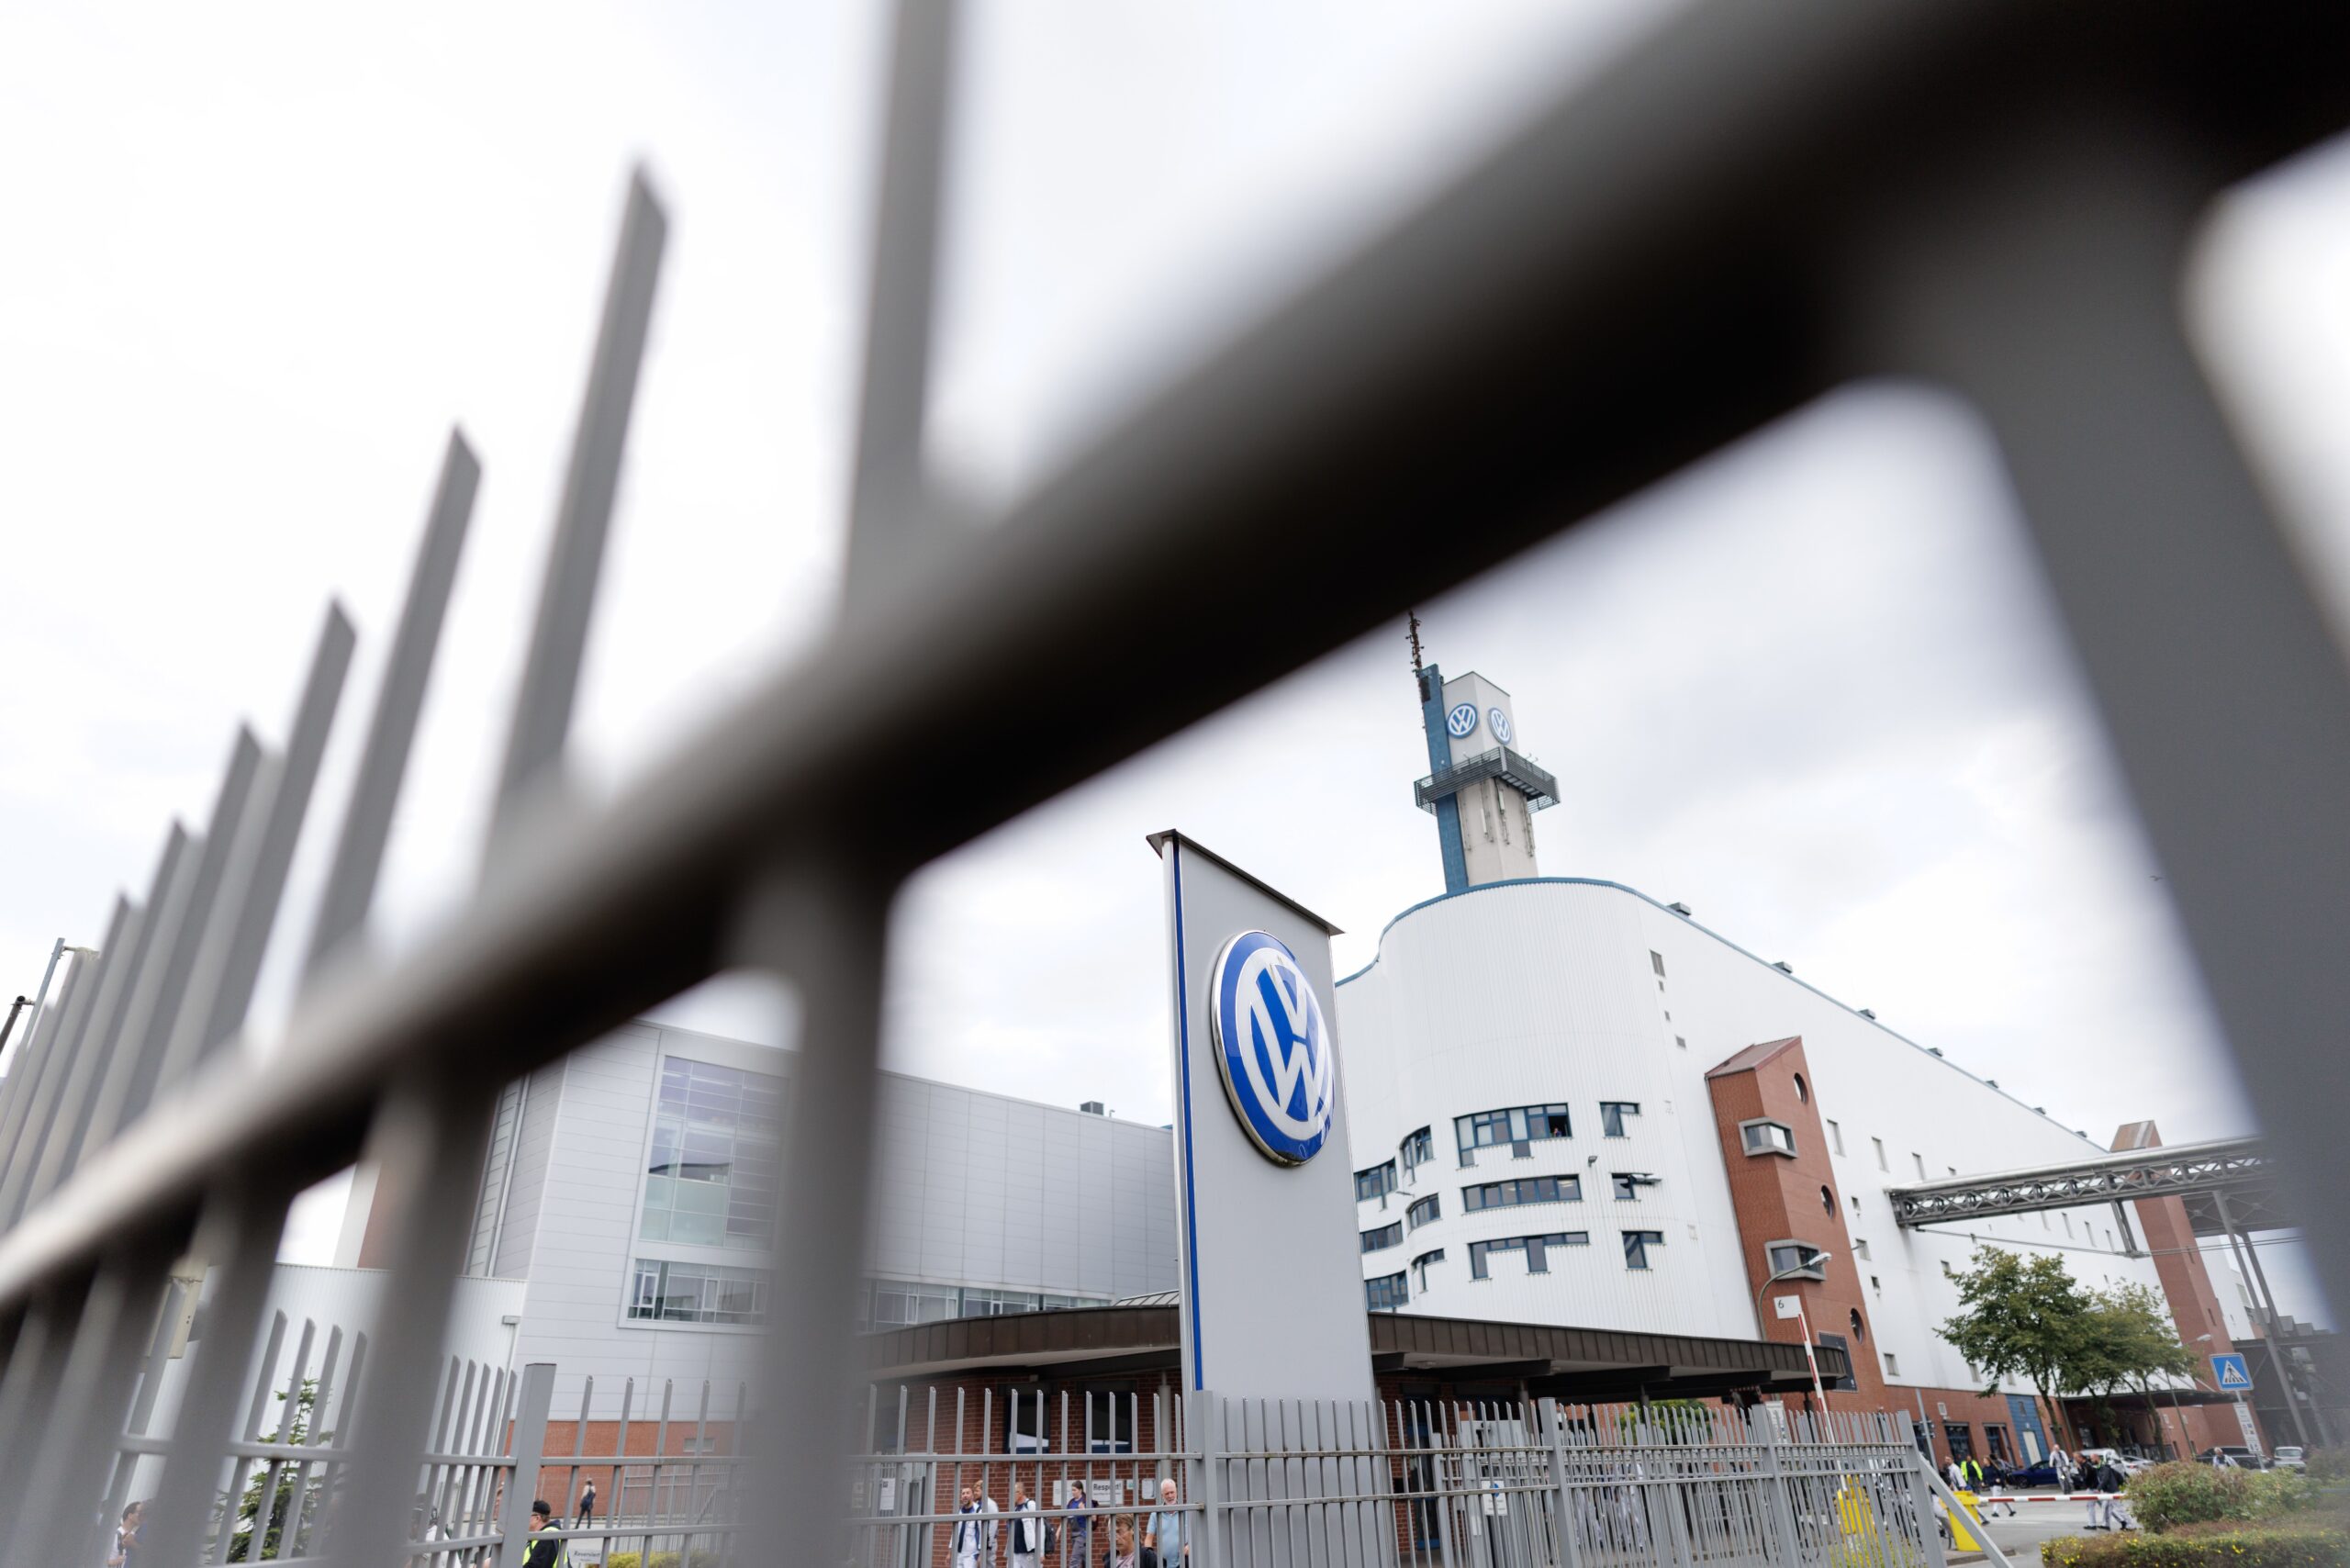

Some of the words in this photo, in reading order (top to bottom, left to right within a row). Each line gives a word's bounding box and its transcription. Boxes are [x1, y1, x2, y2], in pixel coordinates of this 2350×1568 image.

[1448, 703, 1477, 737] VW
[1489, 708, 1512, 744] VW
[1235, 946, 1330, 1141] VW
[1777, 1299, 1785, 1309] 6
